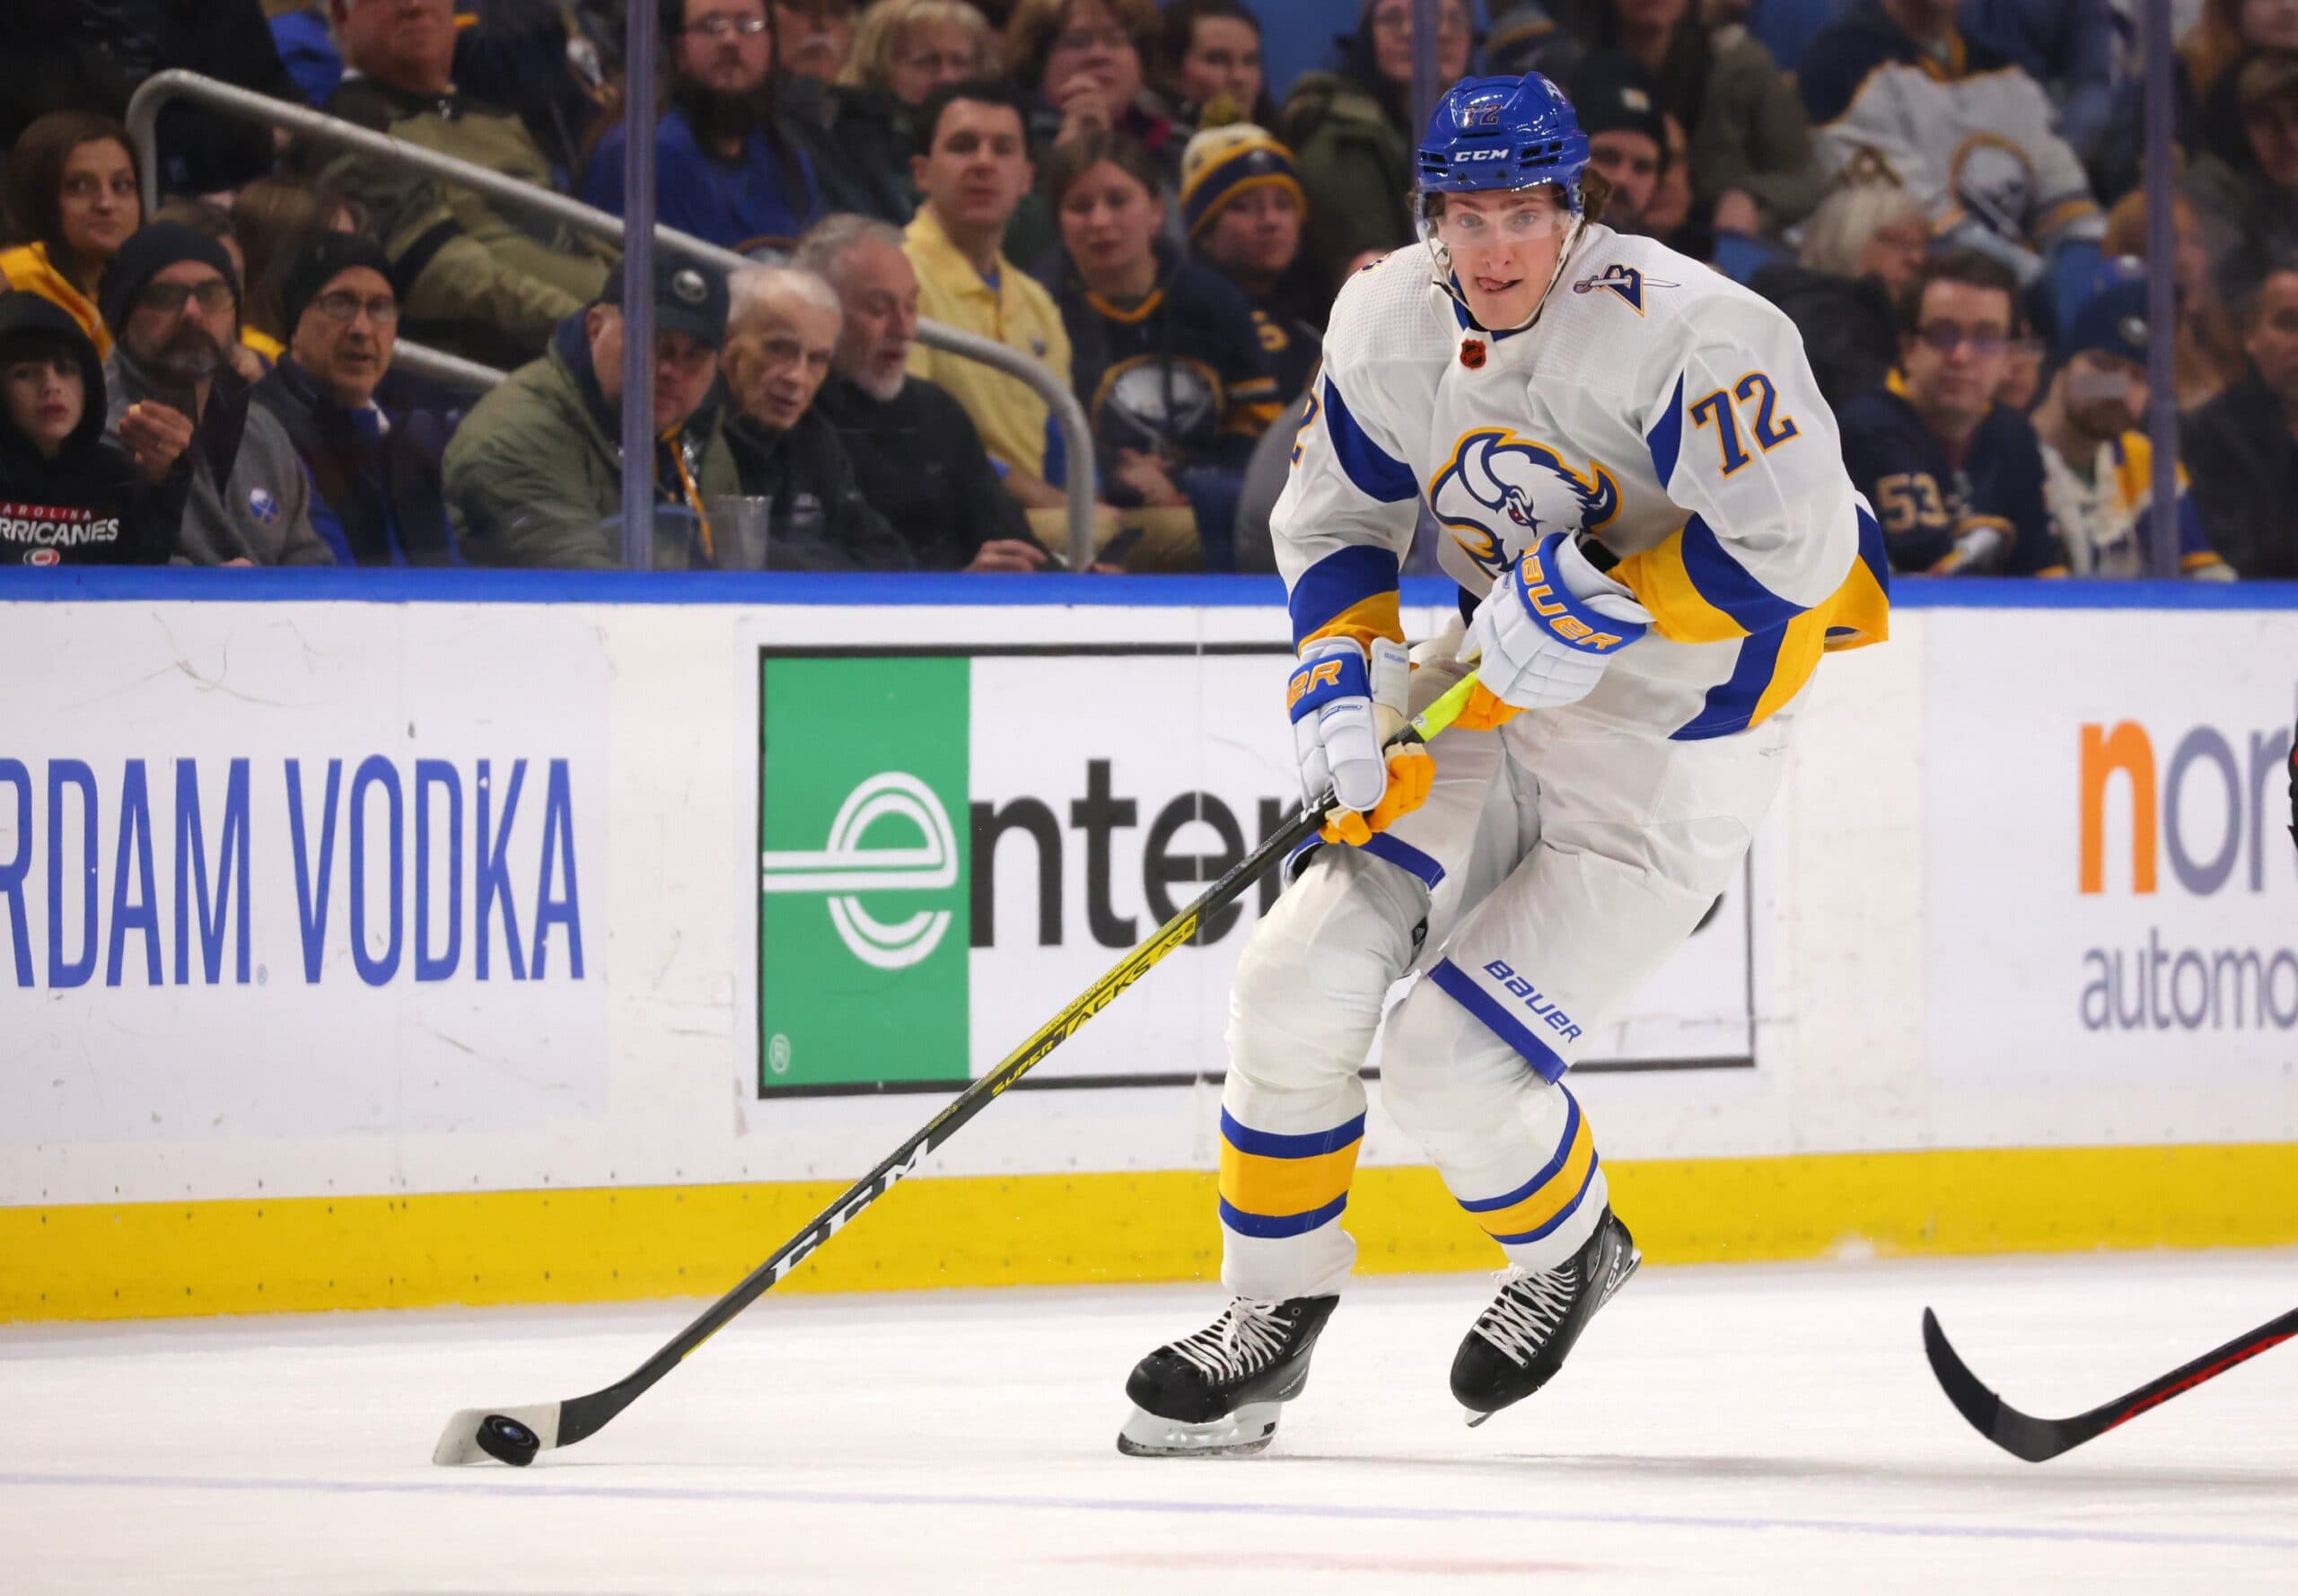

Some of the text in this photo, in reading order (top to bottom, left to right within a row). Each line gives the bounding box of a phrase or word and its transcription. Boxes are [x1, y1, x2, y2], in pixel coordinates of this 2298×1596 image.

[1454, 149, 1509, 162] CCM
[1688, 370, 1802, 479] 72
[0, 517, 119, 546] RRICANES
[1877, 474, 1949, 532] 53
[0, 754, 584, 987] RDAM VODKA
[992, 1039, 1055, 1097] SUPER
[1052, 957, 1151, 1043] TACKS
[1482, 960, 1583, 1044] BAUER
[2080, 925, 2298, 1030] automo
[770, 1137, 928, 1282] CCM
